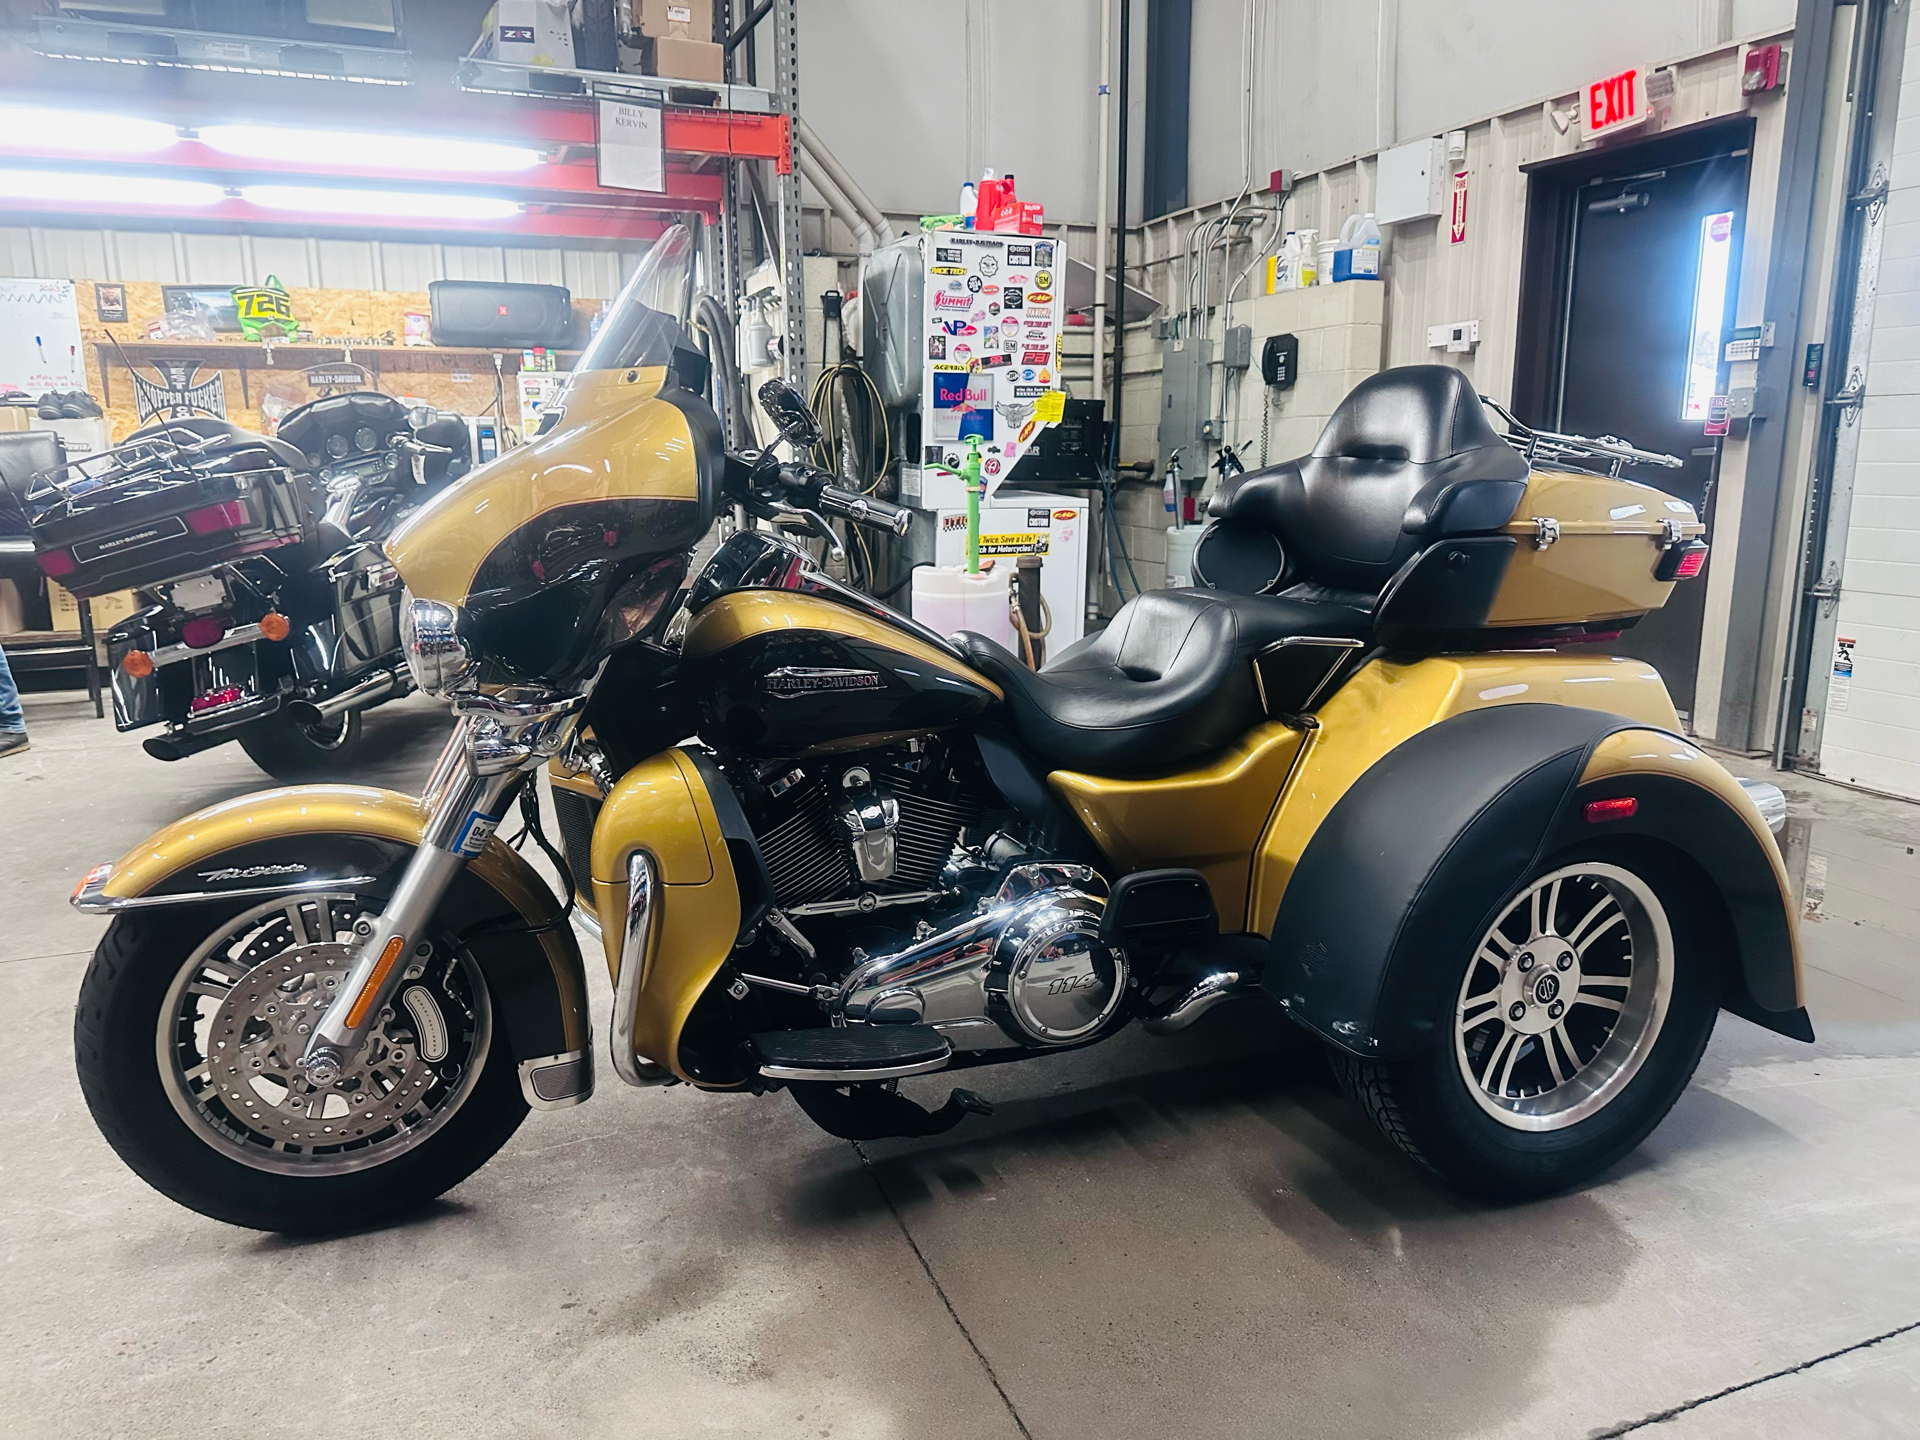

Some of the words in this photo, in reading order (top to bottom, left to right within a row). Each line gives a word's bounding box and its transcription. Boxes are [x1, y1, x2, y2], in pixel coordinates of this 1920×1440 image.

[1590, 69, 1637, 130] EXIT
[619, 106, 644, 118] BILLY
[615, 117, 648, 129] KERVIN
[1456, 178, 1466, 190] FIRE
[931, 267, 948, 275] RACE
[237, 293, 291, 318] 726
[943, 320, 967, 336] VP
[164, 361, 188, 389] WEST
[310, 374, 362, 384] HARLEY-DAVIDSON
[136, 378, 183, 419] CHOPPER
[184, 379, 225, 421] FUCKER
[940, 387, 963, 401] Red
[964, 388, 987, 401] Bull
[1710, 397, 1729, 406] FIRE
[1054, 511, 1077, 519] FMF
[99, 530, 157, 550] HARLEY-DAVIDSON
[1000, 535, 1015, 543] Save
[997, 544, 1034, 554] Motorcycles!
[766, 675, 880, 690] HARLEY-DAVIDSON
[1047, 971, 1099, 996] 114
